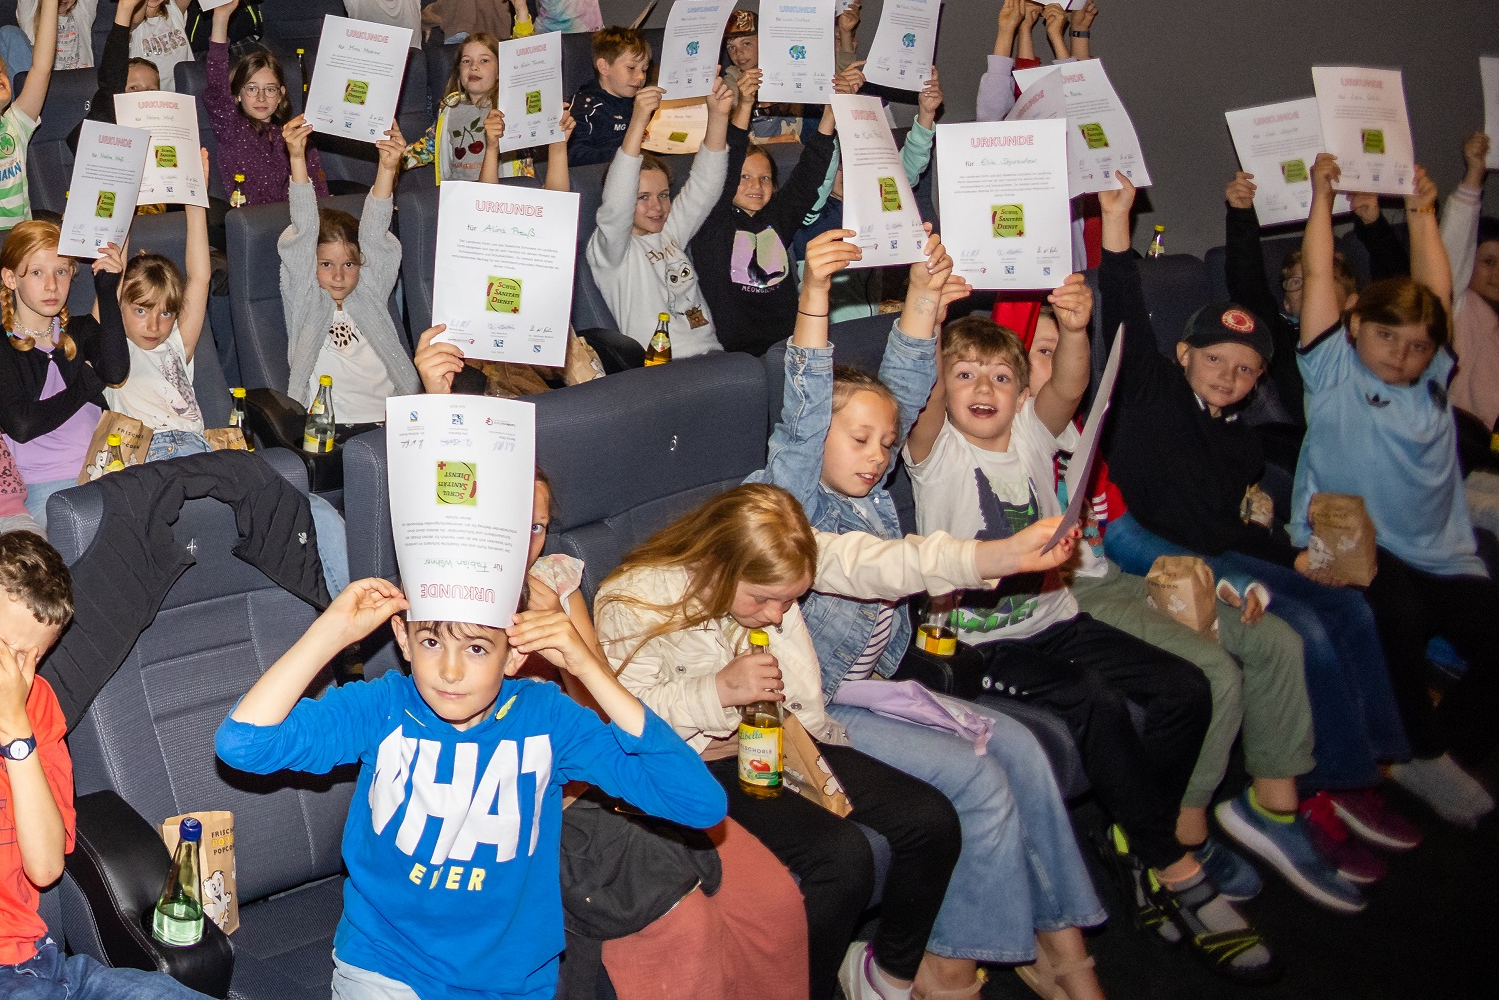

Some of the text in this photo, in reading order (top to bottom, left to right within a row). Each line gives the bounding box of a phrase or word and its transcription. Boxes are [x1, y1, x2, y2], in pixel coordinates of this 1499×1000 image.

[780, 5, 816, 13] URKUNDE
[345, 30, 389, 43] URKUNDE
[517, 44, 547, 55] URKUNDE
[140, 101, 179, 110] URKUNDE
[613, 123, 626, 131] MG
[99, 135, 132, 147] URKUNDE
[970, 135, 1034, 148] URKUNDE
[475, 200, 544, 217] URKUNDE
[497, 281, 516, 291] SCHUL
[492, 297, 514, 305] DIENST
[444, 472, 471, 481] DIENST
[438, 481, 468, 491] SANITÄTS
[442, 490, 465, 500] SCHUL
[457, 559, 490, 572] Fabian
[493, 563, 503, 572] für
[420, 584, 495, 603] URKUNDE
[368, 724, 553, 865] WHAT
